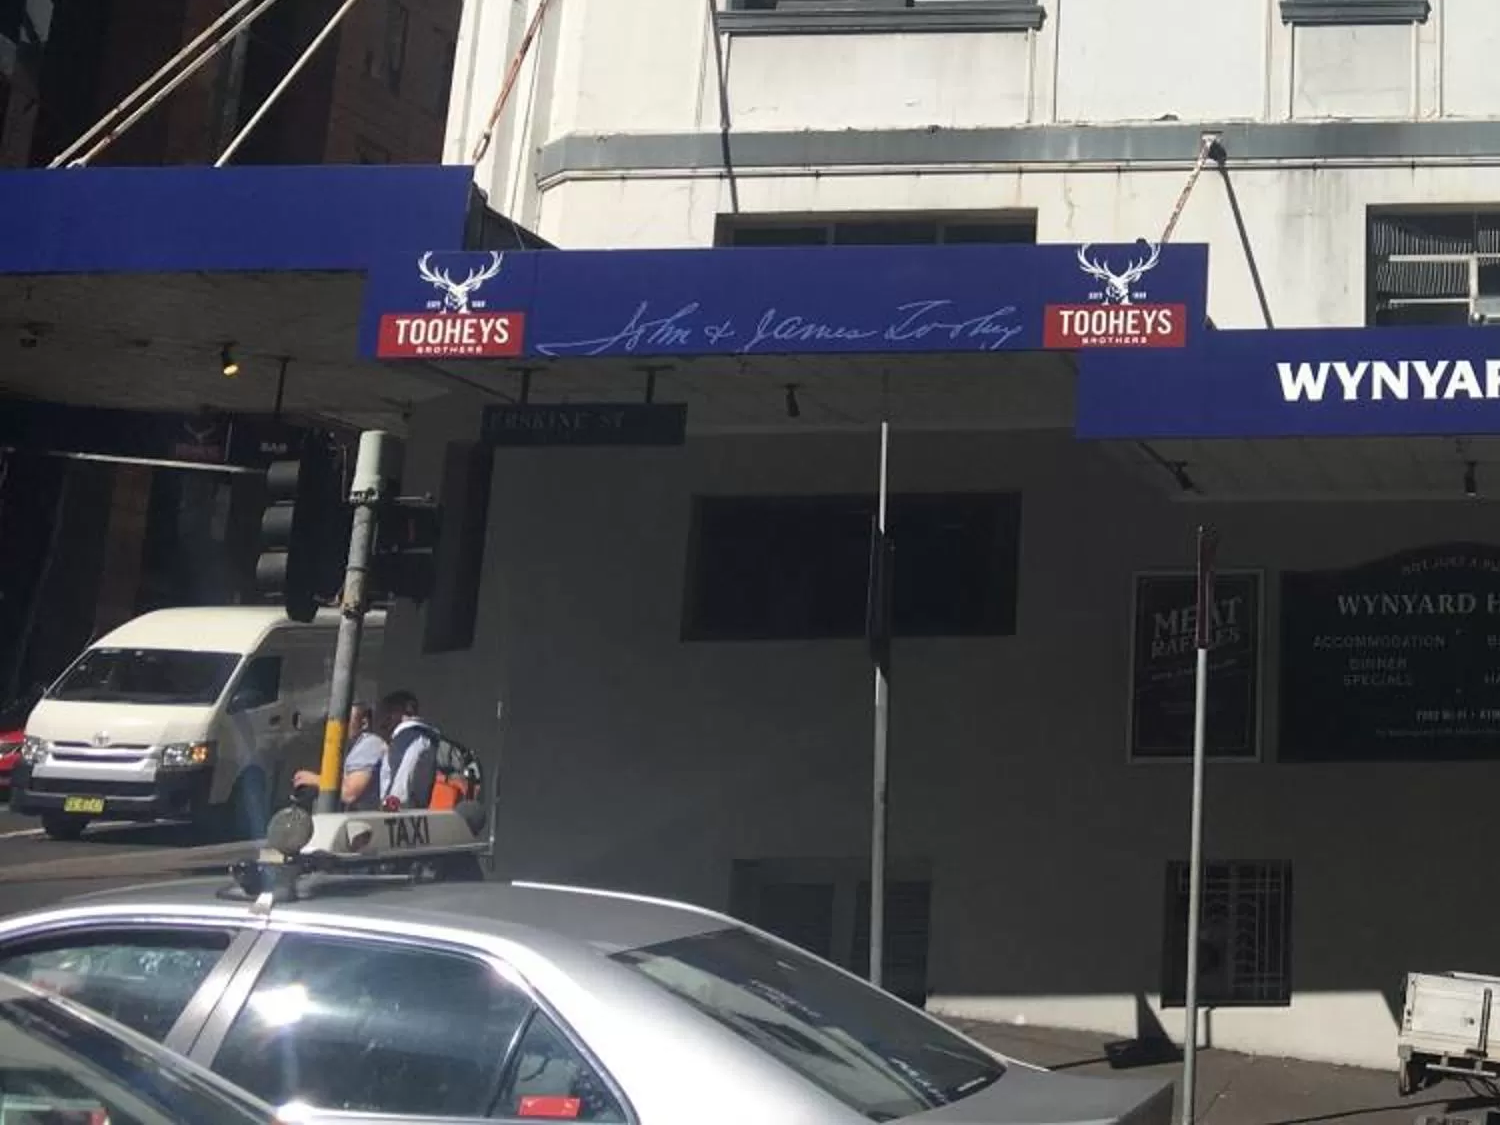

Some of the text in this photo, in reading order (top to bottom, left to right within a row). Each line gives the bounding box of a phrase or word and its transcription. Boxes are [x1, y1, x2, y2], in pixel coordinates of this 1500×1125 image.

[396, 318, 509, 345] TOOHEYS
[1059, 309, 1172, 336] TOOHEYS
[416, 346, 483, 354] BROTHERS
[1082, 336, 1148, 345] BROTHERS
[1337, 592, 1477, 615] WYNYARD
[1312, 634, 1447, 650] ACCOMMODATION
[384, 816, 431, 848] TAXI
